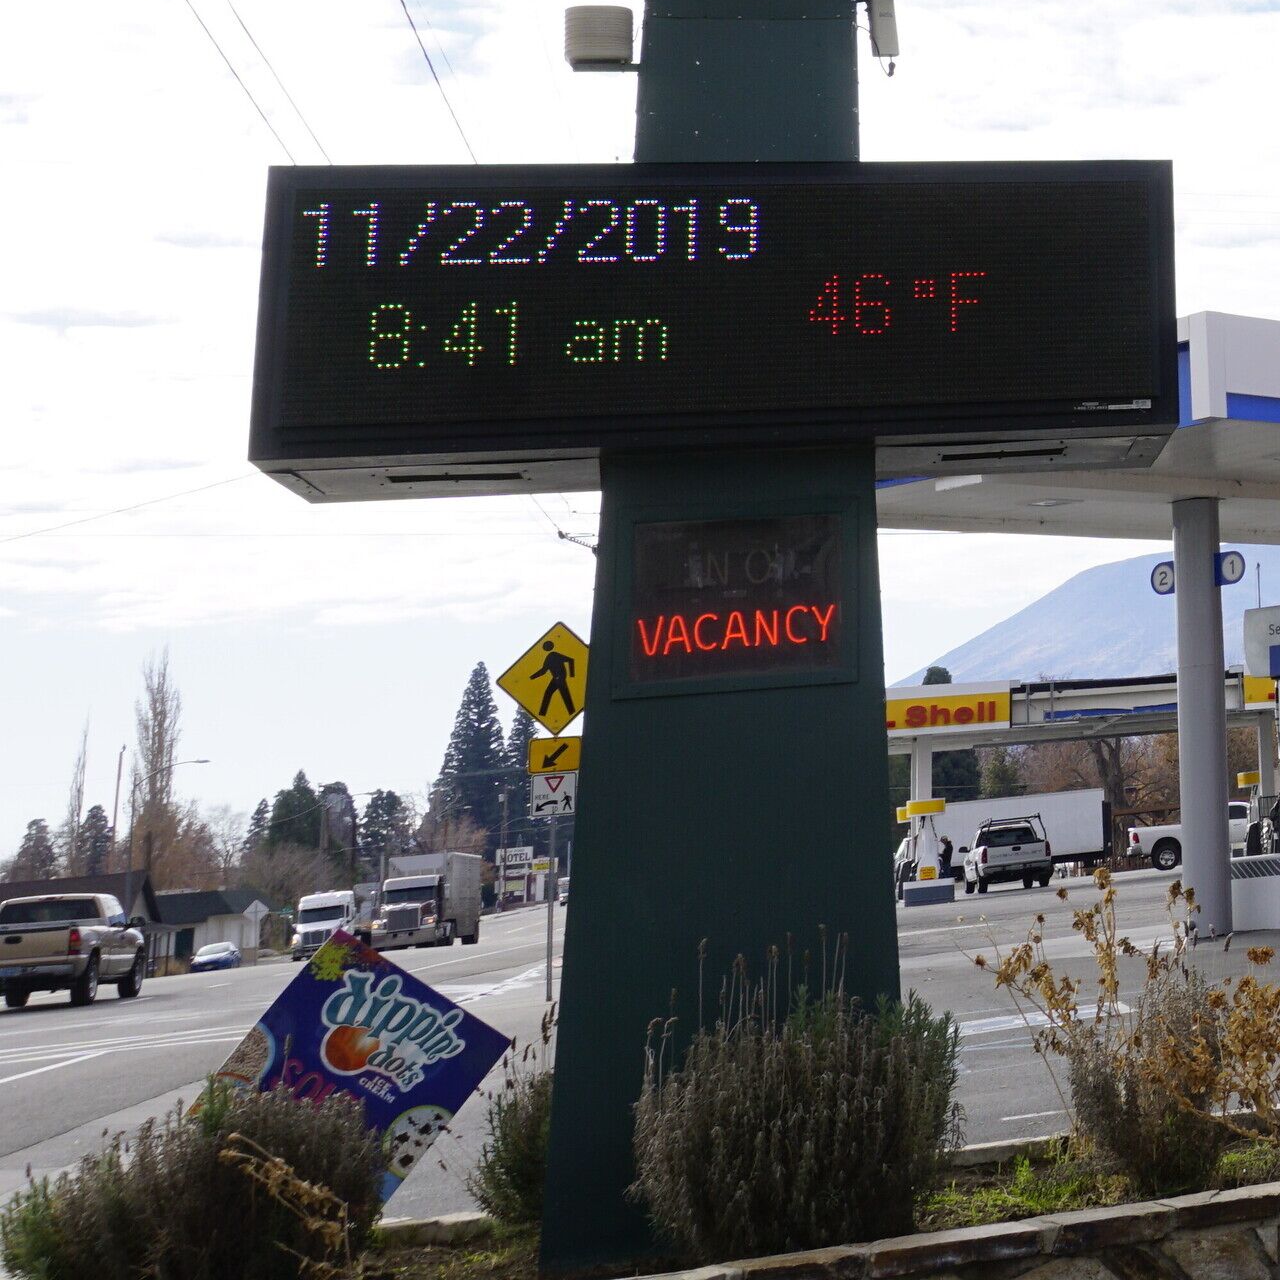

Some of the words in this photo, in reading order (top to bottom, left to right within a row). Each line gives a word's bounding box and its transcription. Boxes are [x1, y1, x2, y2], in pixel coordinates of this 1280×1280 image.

[302, 198, 762, 268] 11/22/2019
[368, 300, 518, 369] 8:41
[566, 319, 669, 363] am
[1159, 570, 1169, 586] 2
[1228, 559, 1235, 575] 1
[637, 603, 838, 657] VACANCY
[905, 700, 996, 728] Shell
[366, 1044, 421, 1087] dots
[360, 1077, 397, 1104] CREAM
[373, 1075, 394, 1094] ICE
